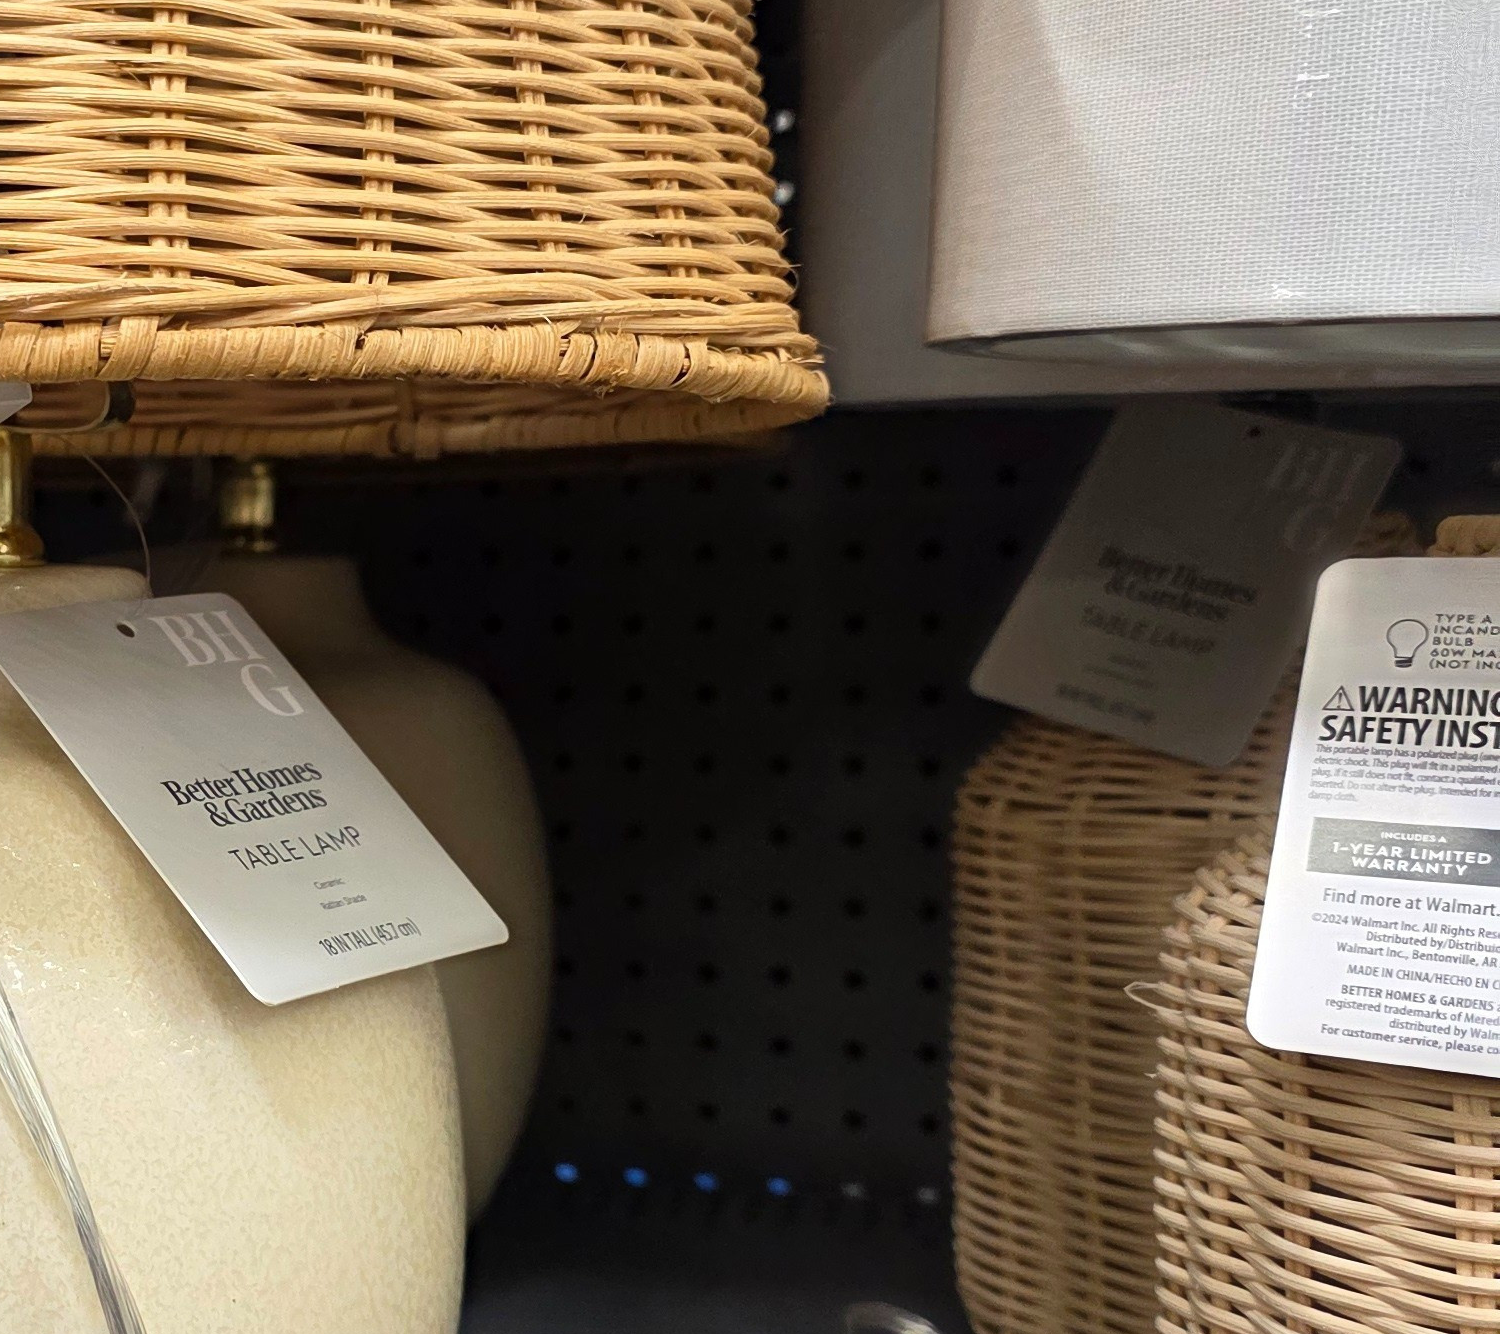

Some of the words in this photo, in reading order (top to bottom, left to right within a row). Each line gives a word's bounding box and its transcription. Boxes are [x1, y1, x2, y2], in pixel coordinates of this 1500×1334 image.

[1435, 613, 1476, 624] TYPE
[1481, 614, 1492, 624] A
[1432, 636, 1474, 647] BULB
[1433, 625, 1500, 636] INCAND
[1429, 658, 1470, 669] (NOT
[1430, 648, 1466, 657] 60W
[1471, 649, 1500, 659] MA
[1318, 714, 1433, 746] SAFETY
[1313, 755, 1344, 765] electric
[1333, 746, 1370, 756] portable
[1370, 747, 1393, 758] lamp
[1416, 749, 1458, 760] polarized
[1457, 751, 1479, 762] plug
[161, 776, 242, 806] Better
[233, 762, 323, 794] Homes
[228, 839, 304, 870] TABLE
[298, 825, 361, 857] LAMP
[1380, 831, 1437, 842] INCLUDES
[1436, 835, 1447, 843] A
[1332, 842, 1403, 858] 1-YEAR
[1410, 847, 1493, 865] LIMITED
[1351, 856, 1468, 876] WARRANTY
[1323, 887, 1357, 904] Find
[1359, 894, 1402, 908] more
[1404, 897, 1422, 910] at
[319, 938, 339, 956] 18
[343, 928, 378, 949] TALL
[397, 916, 422, 937] cm)
[1351, 915, 1399, 930] Walmart
[1400, 920, 1420, 932] Inc.
[1422, 923, 1438, 933] All
[1440, 924, 1475, 938] Rights
[1366, 930, 1428, 947] Distributed
[1336, 941, 1384, 957] Walmart
[1412, 949, 1479, 967] Bentonville,
[1481, 956, 1498, 967] AR
[1346, 964, 1379, 977] MADE
[1381, 967, 1394, 978] IN
[1395, 968, 1473, 987] CHINA/HECHO
[1475, 977, 1489, 989] EN
[1341, 984, 1383, 998] BETTER
[1384, 989, 1427, 1004] HOMES
[1427, 994, 1437, 1005] &
[1440, 995, 1494, 1011] GARDENS
[1325, 998, 1381, 1012] registered
[1384, 1003, 1448, 1020] trademarks
[1449, 1012, 1463, 1022] of
[1320, 1023, 1340, 1035] For
[1341, 1028, 1397, 1042] customer
[1397, 1035, 1443, 1049] service,
[1445, 1039, 1484, 1054] please
[1388, 1017, 1451, 1035] distributed
[1453, 1025, 1467, 1039] by
